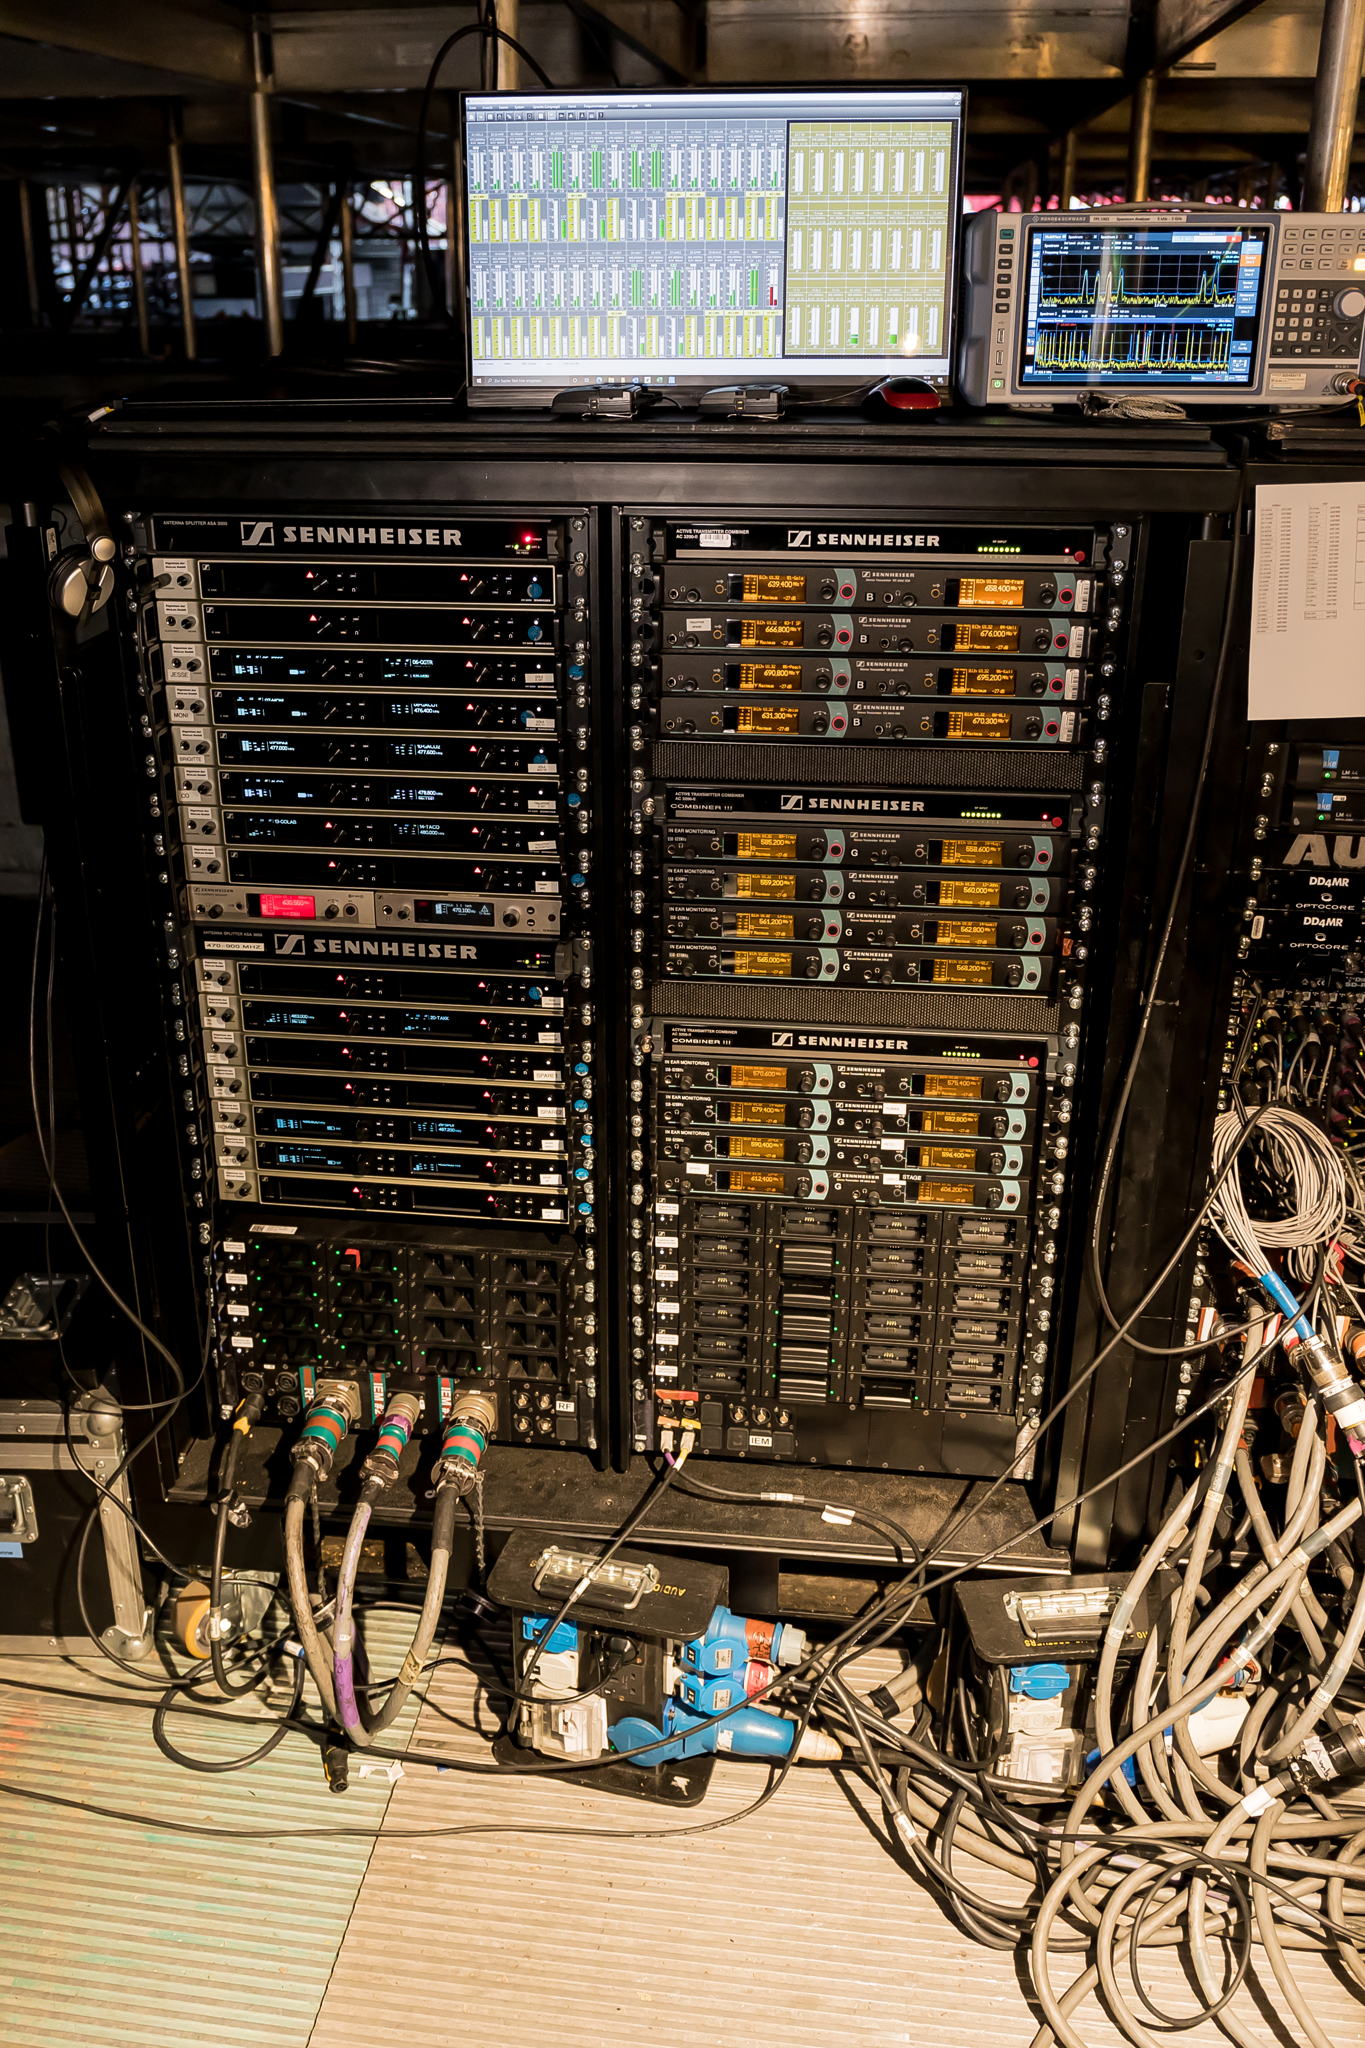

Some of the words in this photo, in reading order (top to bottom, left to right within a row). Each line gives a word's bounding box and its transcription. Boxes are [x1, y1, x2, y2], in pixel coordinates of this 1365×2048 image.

[283, 526, 462, 547] SENNHEISER
[816, 533, 940, 547] SENNHEISER
[866, 593, 874, 601] B
[860, 634, 867, 643] B
[857, 681, 864, 689] B
[853, 718, 861, 727] B
[670, 803, 722, 811] COMBINER
[808, 798, 925, 812] SENNHEISER
[851, 849, 858, 857] G
[1309, 876, 1350, 887] DD4MR
[848, 892, 855, 900] G
[1295, 903, 1356, 911] OPTOCORE
[1303, 916, 1343, 927] DD4MR
[845, 929, 853, 937] G
[313, 939, 477, 960] SENNHEISER
[1289, 942, 1350, 950] OPTOCORE
[843, 963, 850, 971] G
[671, 1037, 721, 1045] COMBINER
[798, 1035, 909, 1050] SENNHEISER
[838, 1080, 846, 1089] G
[837, 1118, 845, 1126] G
[837, 1151, 845, 1160] G
[834, 1182, 842, 1190] G
[373, 1382, 385, 1402] IEM
[441, 1386, 452, 1407] IEM
[558, 1402, 572, 1410] RF
[751, 1436, 772, 1446] IEM
[651, 1583, 687, 1597] AUDIO
